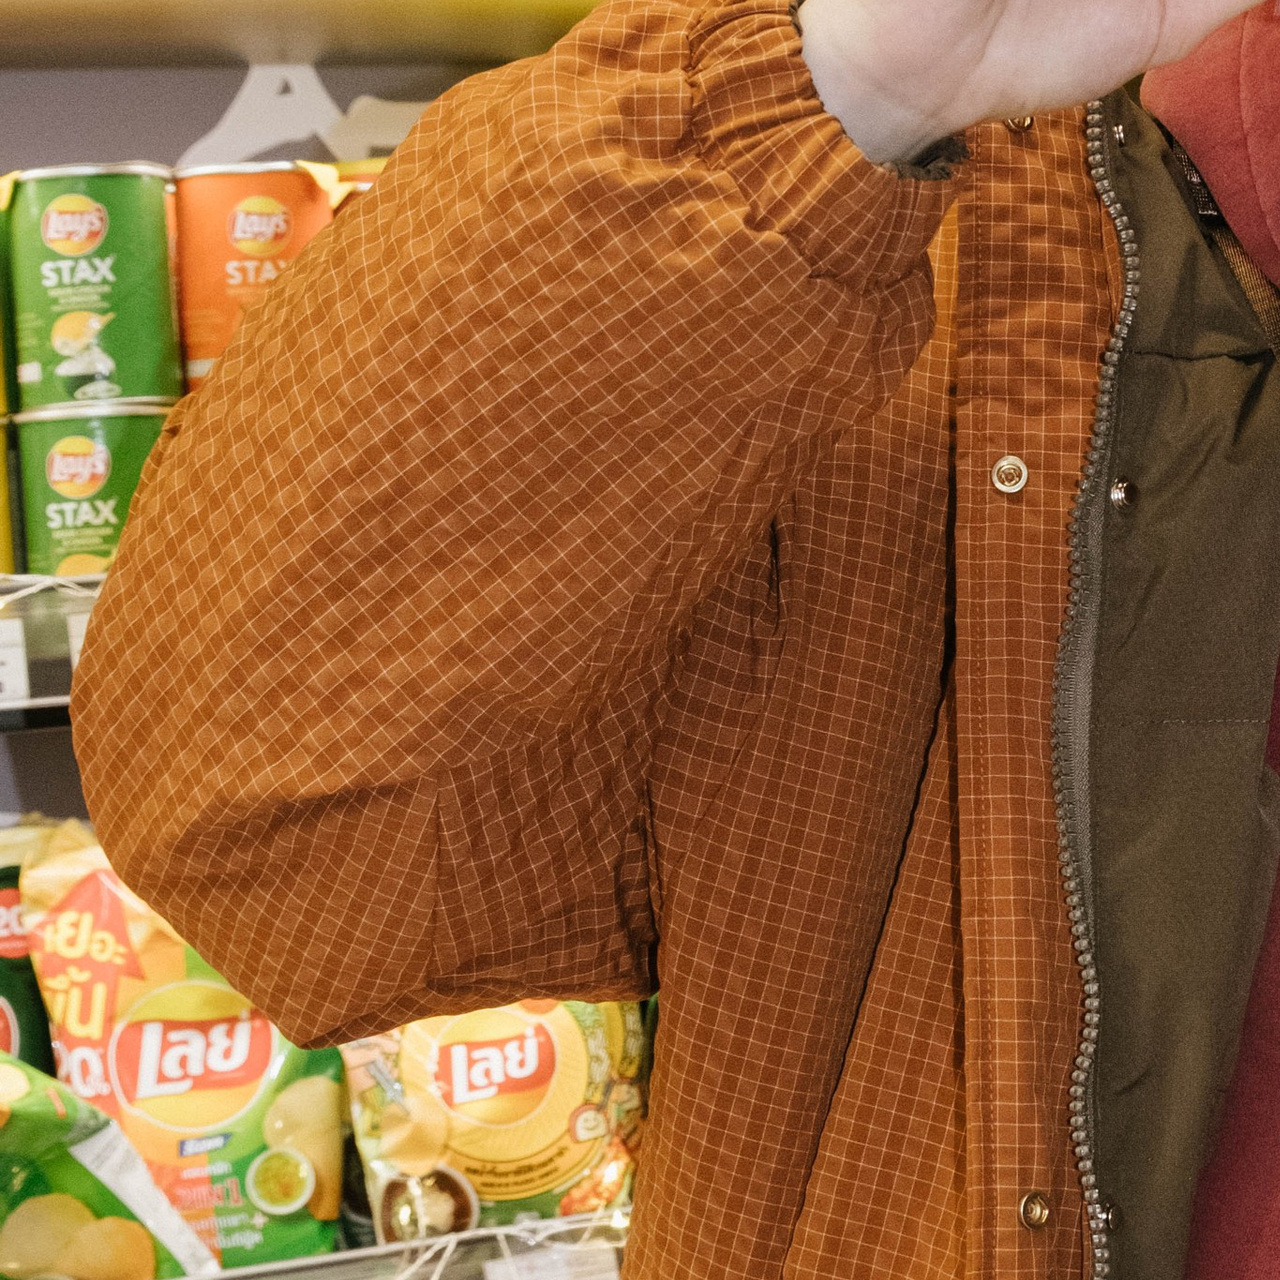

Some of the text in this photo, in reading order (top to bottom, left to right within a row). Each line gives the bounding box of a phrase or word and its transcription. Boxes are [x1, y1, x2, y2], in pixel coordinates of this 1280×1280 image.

[47, 209, 105, 243] Lay's
[232, 210, 287, 241] Lay's
[41, 253, 116, 287] STAX
[225, 260, 290, 286] STA
[51, 448, 107, 485] Lay's
[45, 497, 118, 529] STAX
[450, 1026, 539, 1104] เลย์
